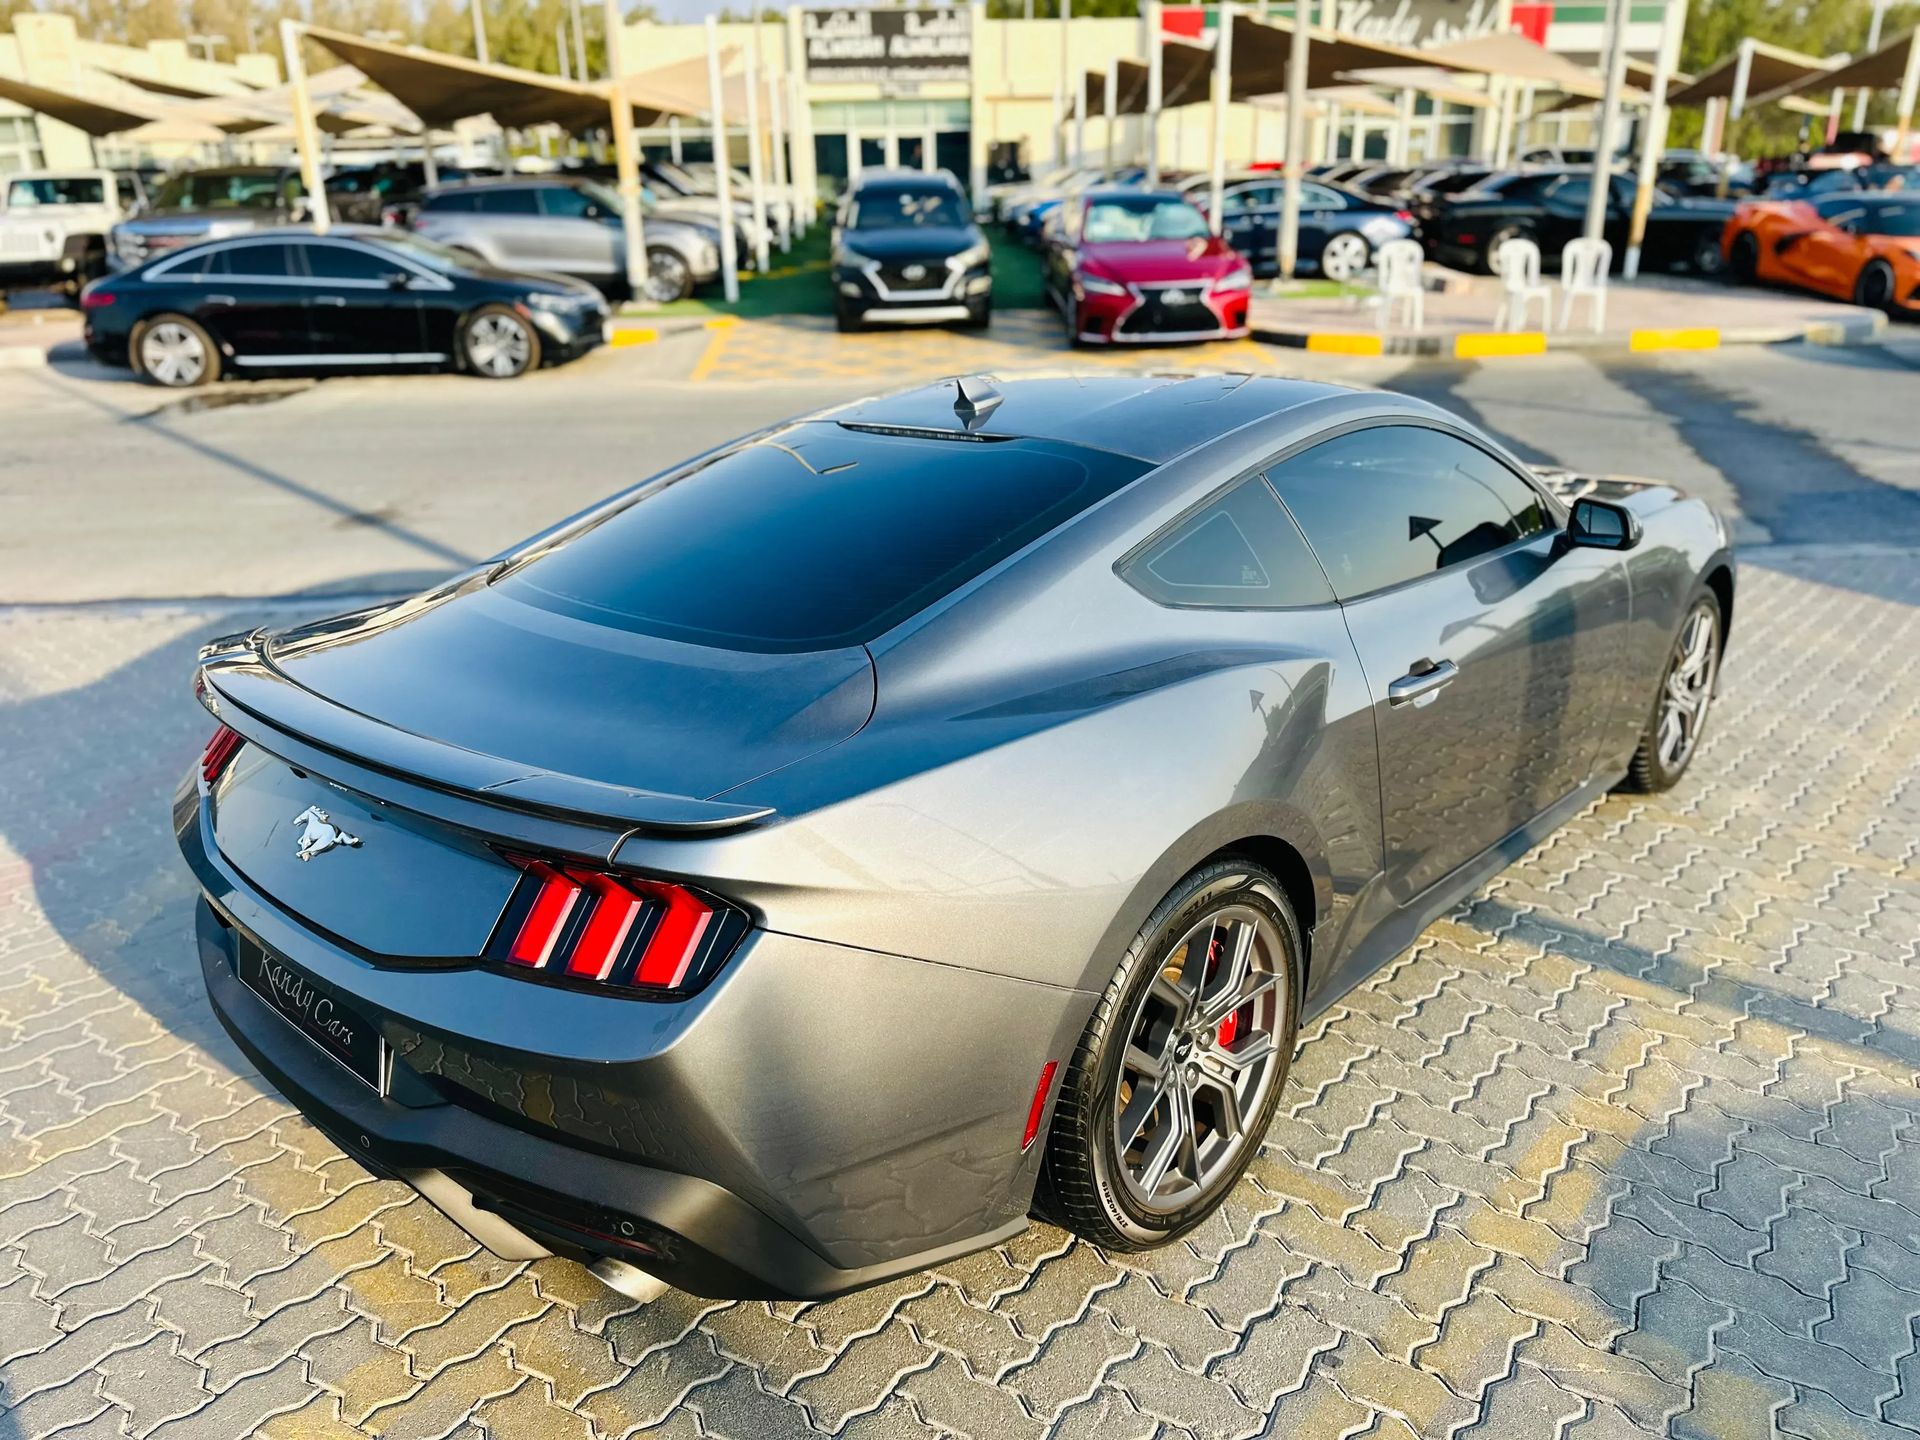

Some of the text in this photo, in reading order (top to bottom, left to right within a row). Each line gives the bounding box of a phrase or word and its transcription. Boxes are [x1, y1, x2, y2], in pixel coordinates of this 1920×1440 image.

[258, 950, 354, 1045] Kandy Cars
[1101, 1181, 1129, 1229] 275/40ZR19
